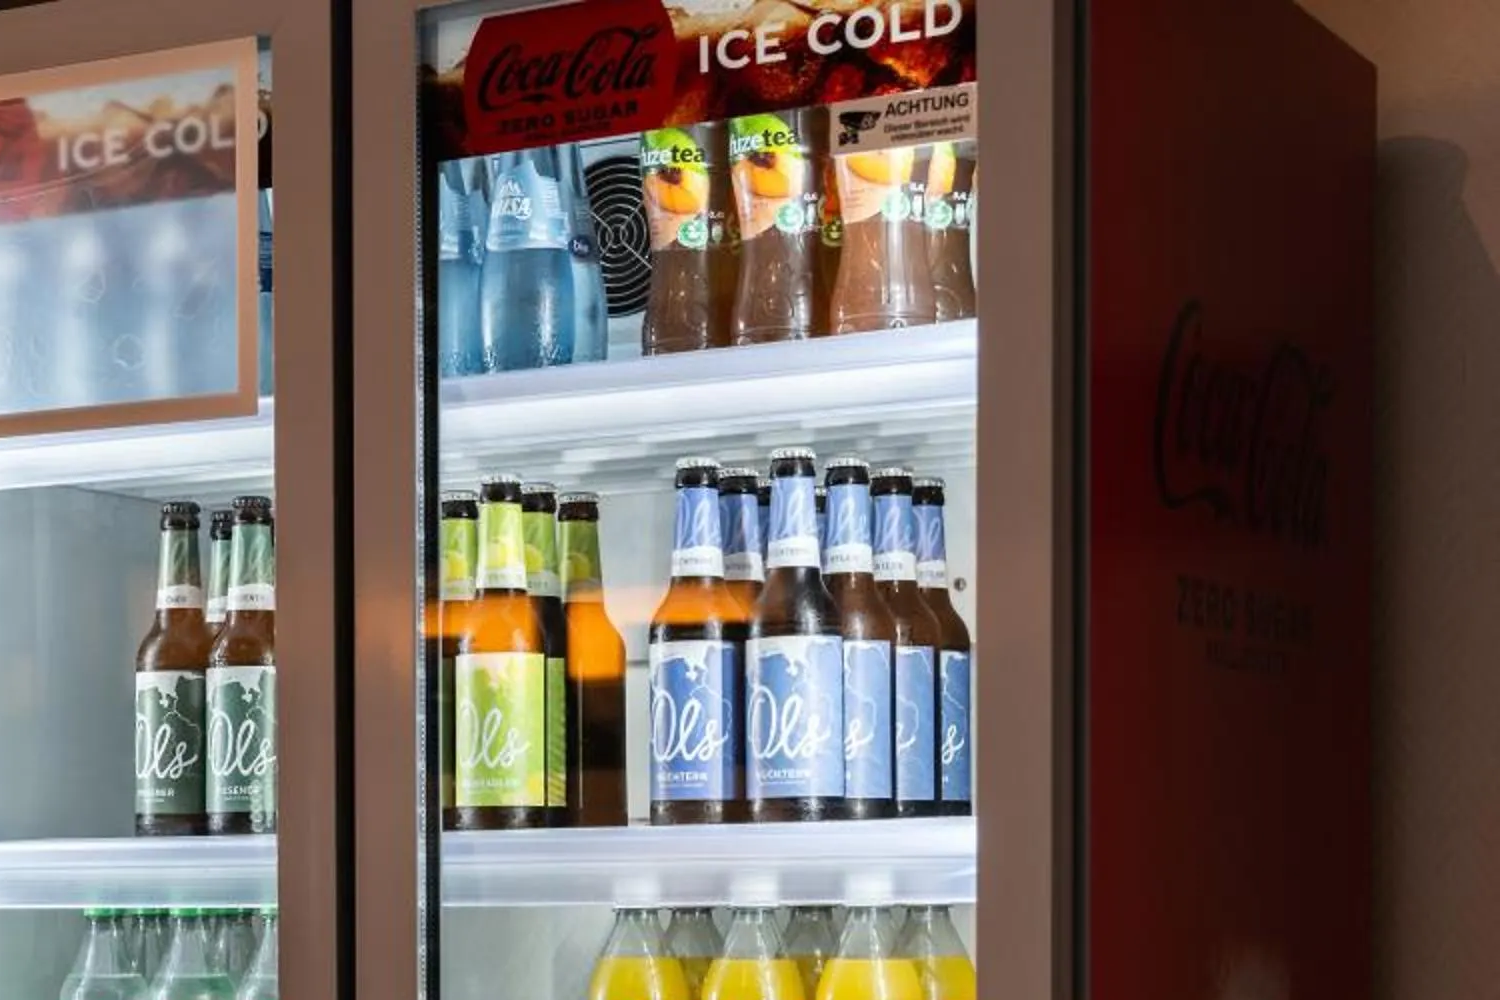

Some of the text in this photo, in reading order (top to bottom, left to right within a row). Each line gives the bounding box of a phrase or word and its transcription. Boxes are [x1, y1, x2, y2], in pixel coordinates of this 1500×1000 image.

[699, 0, 963, 73] ICE COLD
[883, 92, 969, 117] ACHTUNG
[58, 132, 129, 171] ICE
